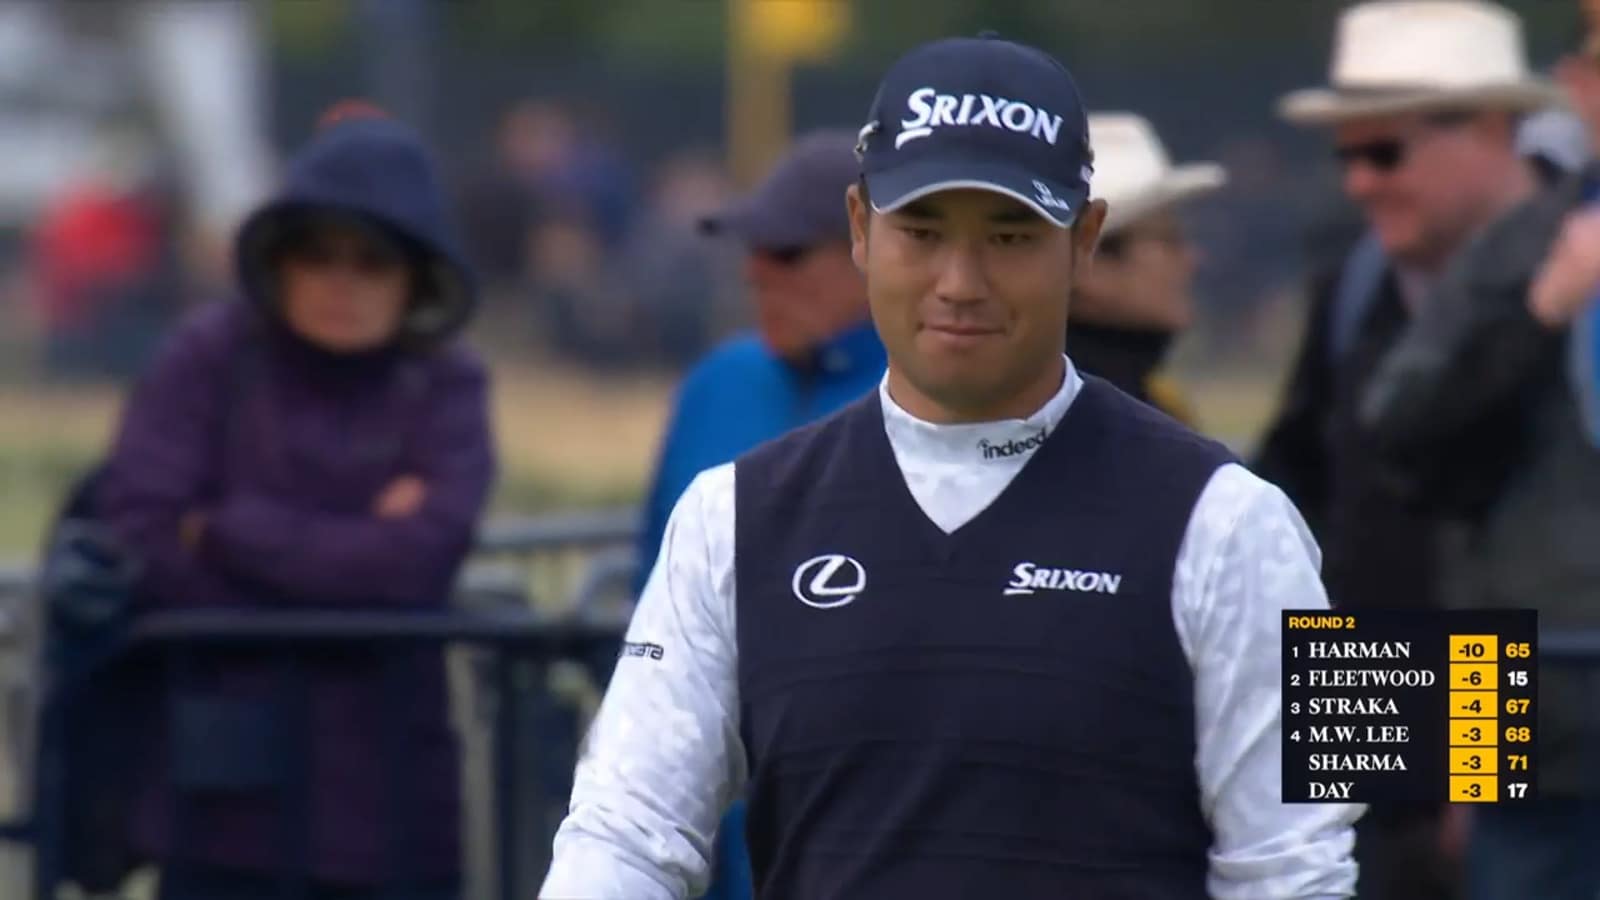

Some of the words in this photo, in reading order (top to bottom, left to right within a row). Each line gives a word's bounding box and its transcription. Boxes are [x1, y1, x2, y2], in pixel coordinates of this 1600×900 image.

[894, 87, 1064, 150] SRIXON
[976, 426, 1046, 459] indeed
[1003, 561, 1122, 596] SRIXON
